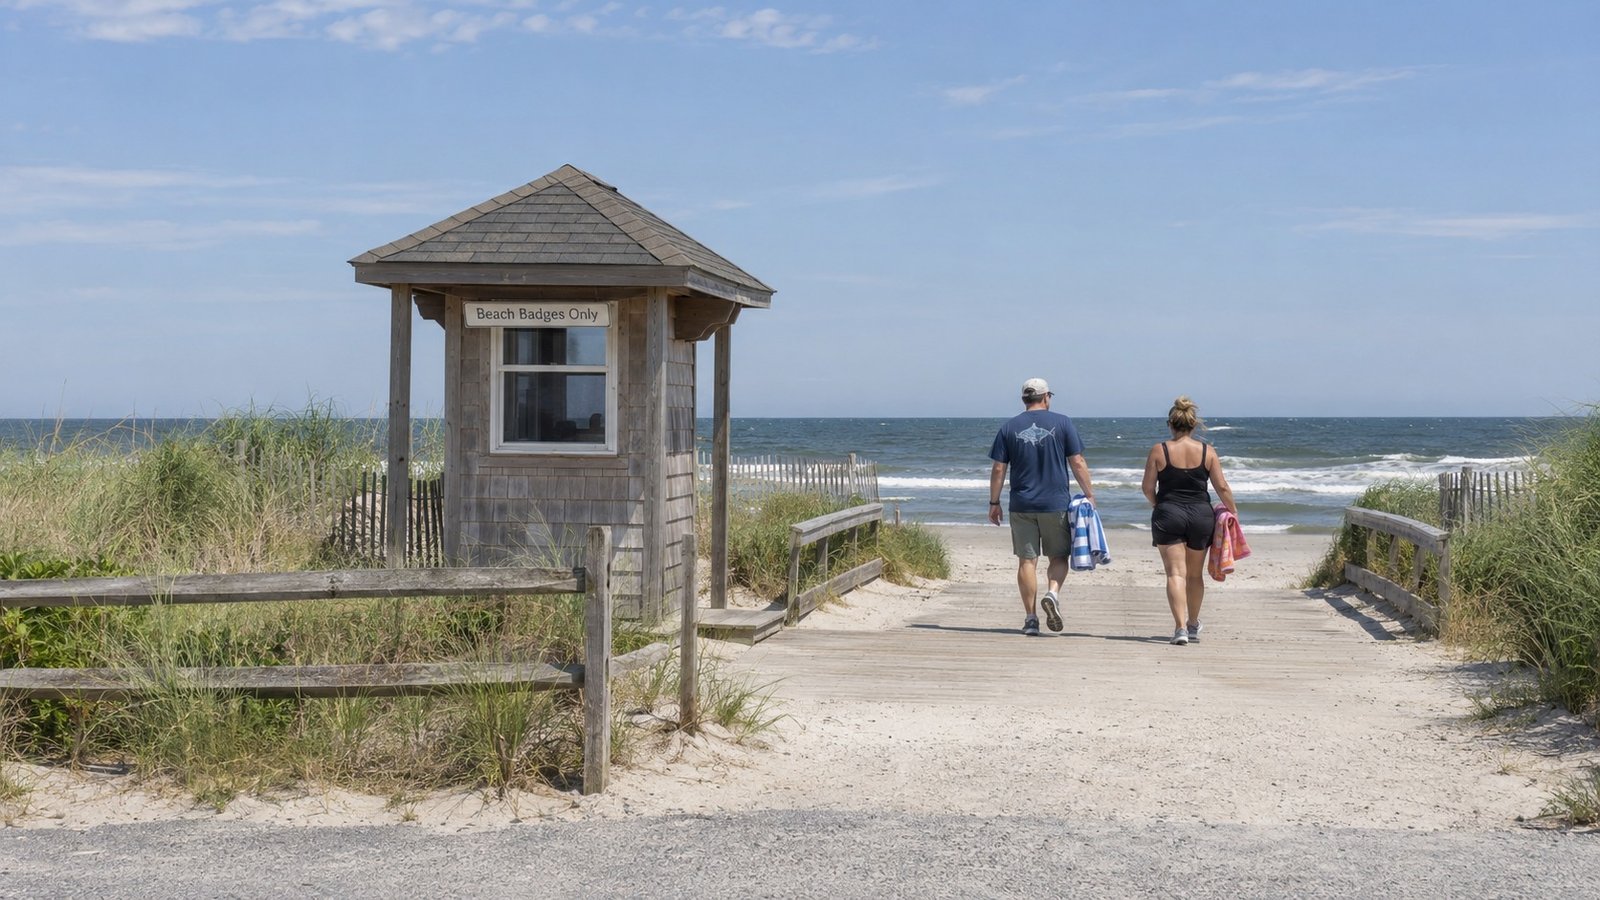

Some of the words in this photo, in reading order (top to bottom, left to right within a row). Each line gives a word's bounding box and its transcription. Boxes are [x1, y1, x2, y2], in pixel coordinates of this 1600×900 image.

[476, 307, 515, 320] Beach
[519, 307, 565, 323] Badges
[568, 307, 598, 323] Only
